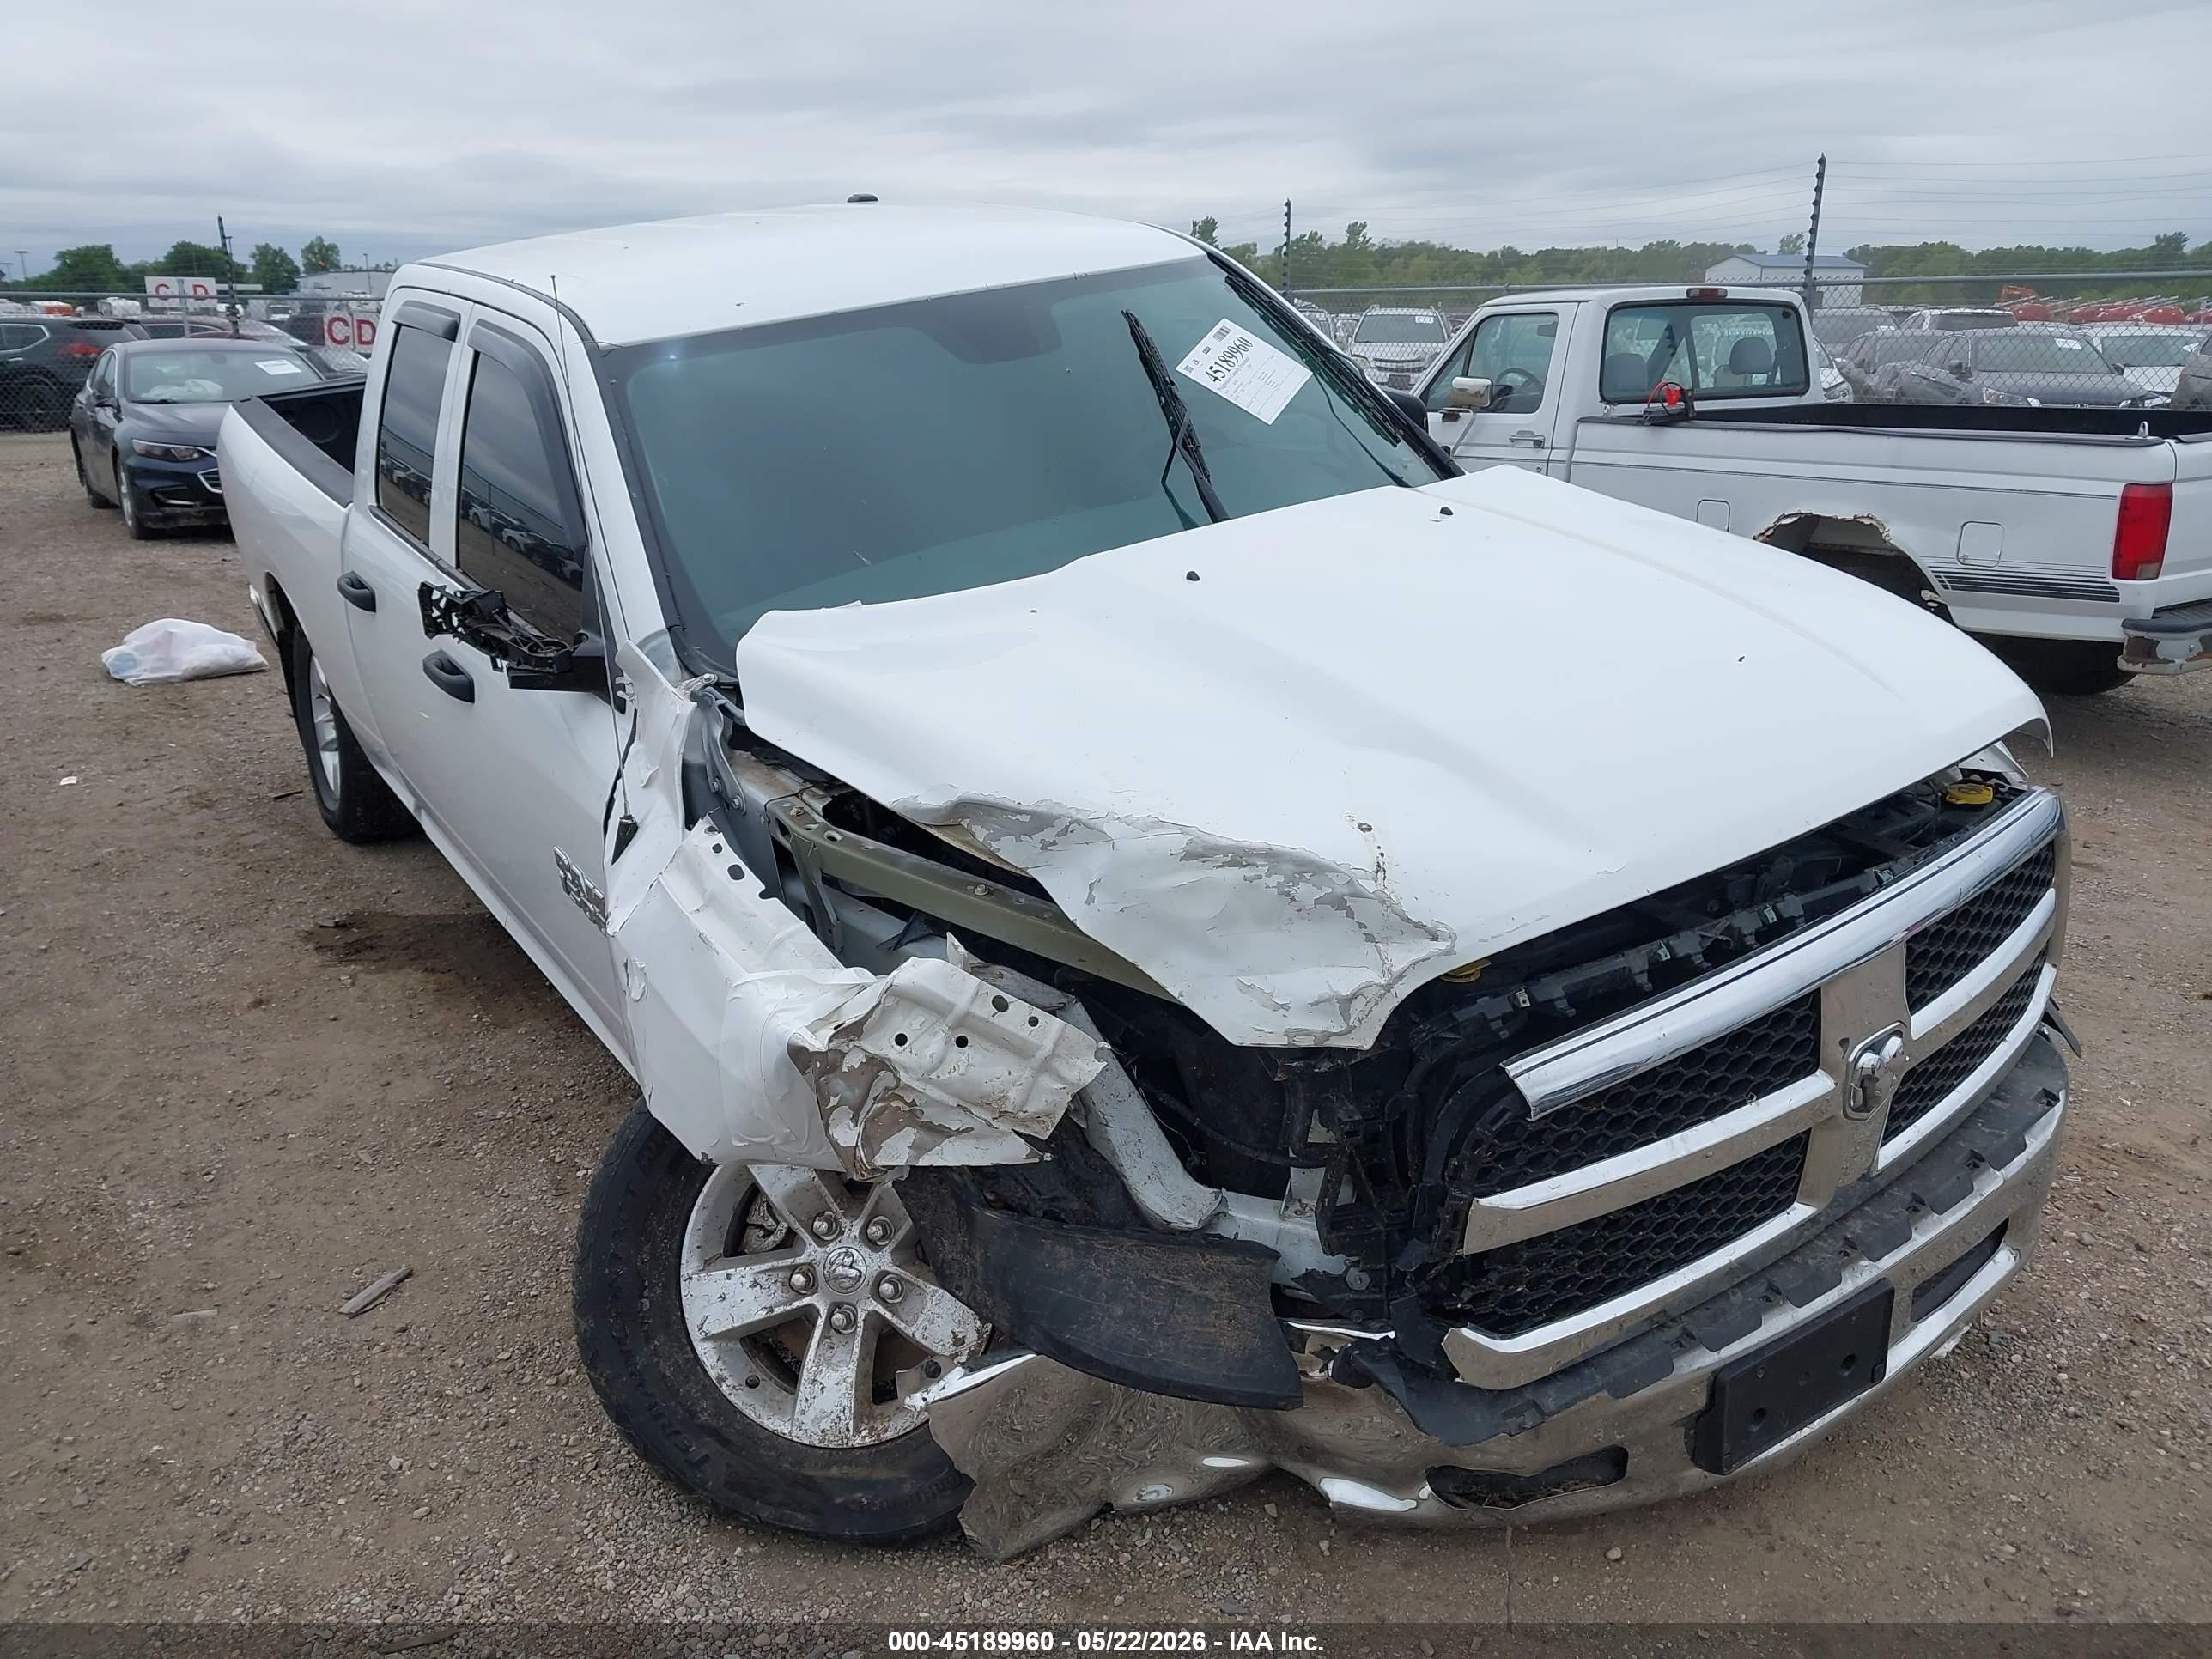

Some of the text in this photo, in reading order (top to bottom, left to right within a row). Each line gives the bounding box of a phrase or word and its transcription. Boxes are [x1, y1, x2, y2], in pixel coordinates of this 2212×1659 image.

[155, 283, 209, 301] C D
[327, 316, 376, 345] C D
[1206, 336, 1253, 382] 45189960
